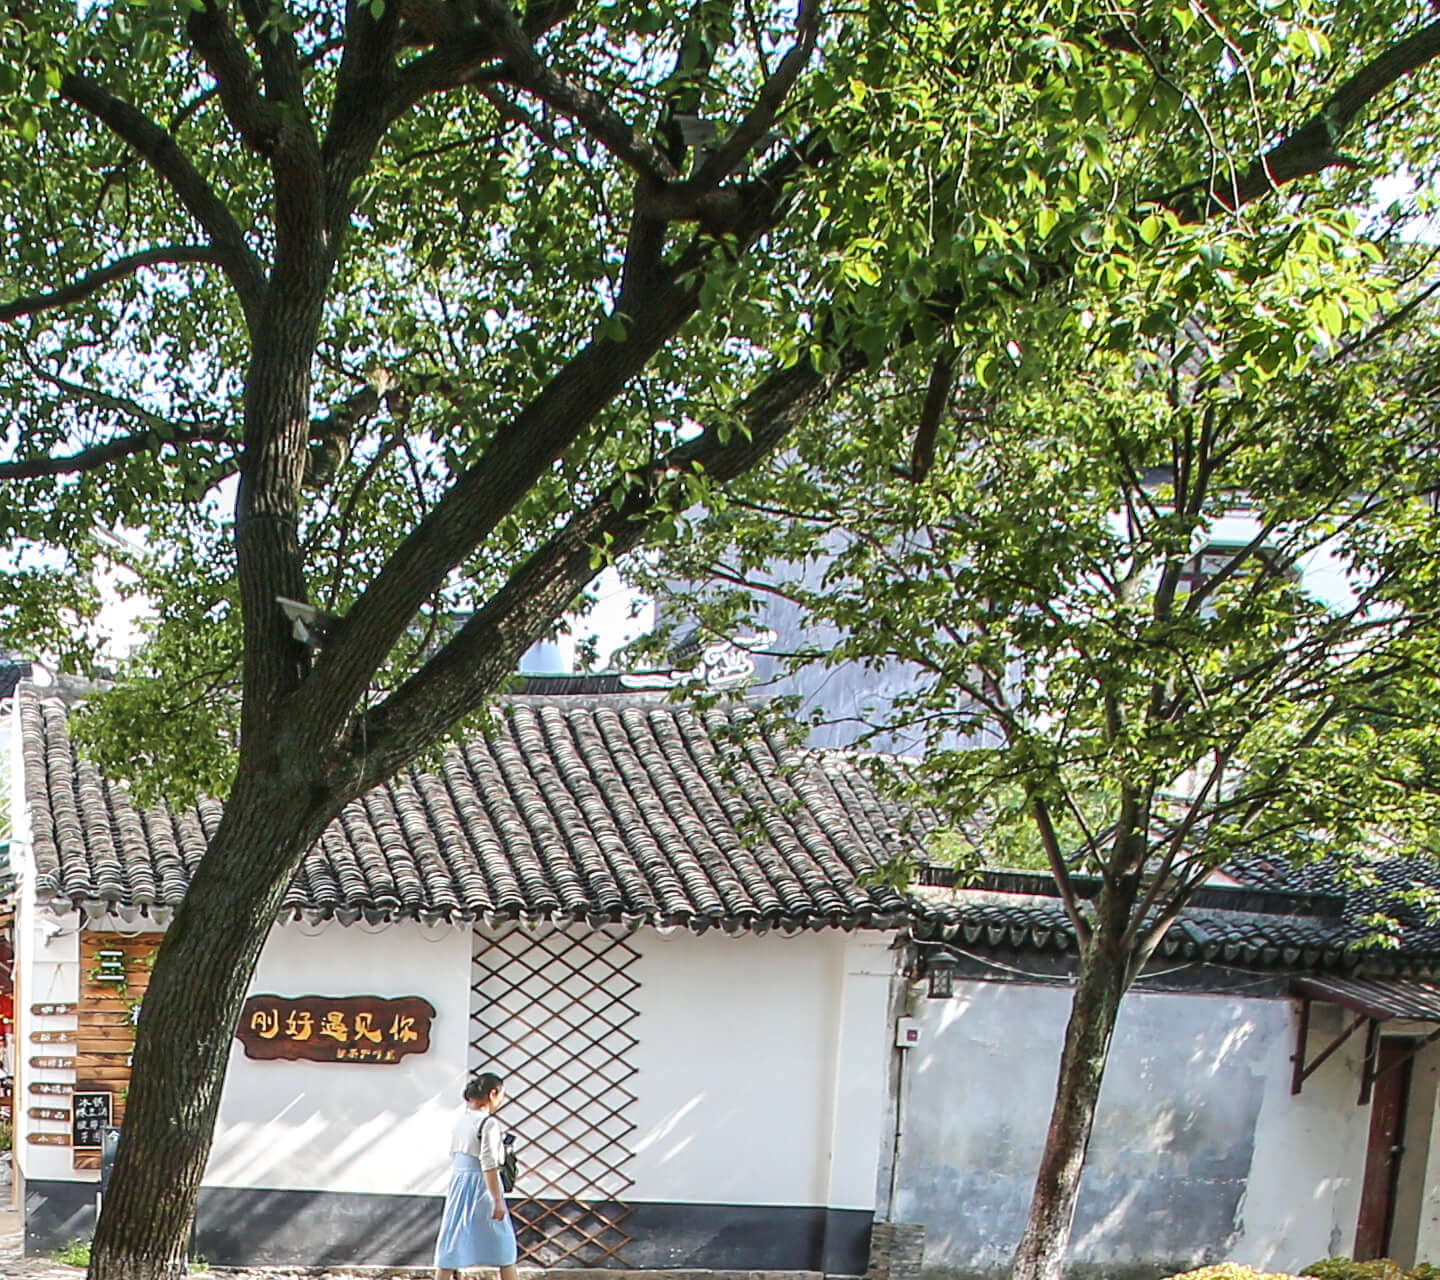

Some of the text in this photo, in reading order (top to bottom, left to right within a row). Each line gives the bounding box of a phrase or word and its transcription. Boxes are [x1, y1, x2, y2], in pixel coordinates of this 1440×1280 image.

[250, 1008, 418, 1043] 刚好遇见你
